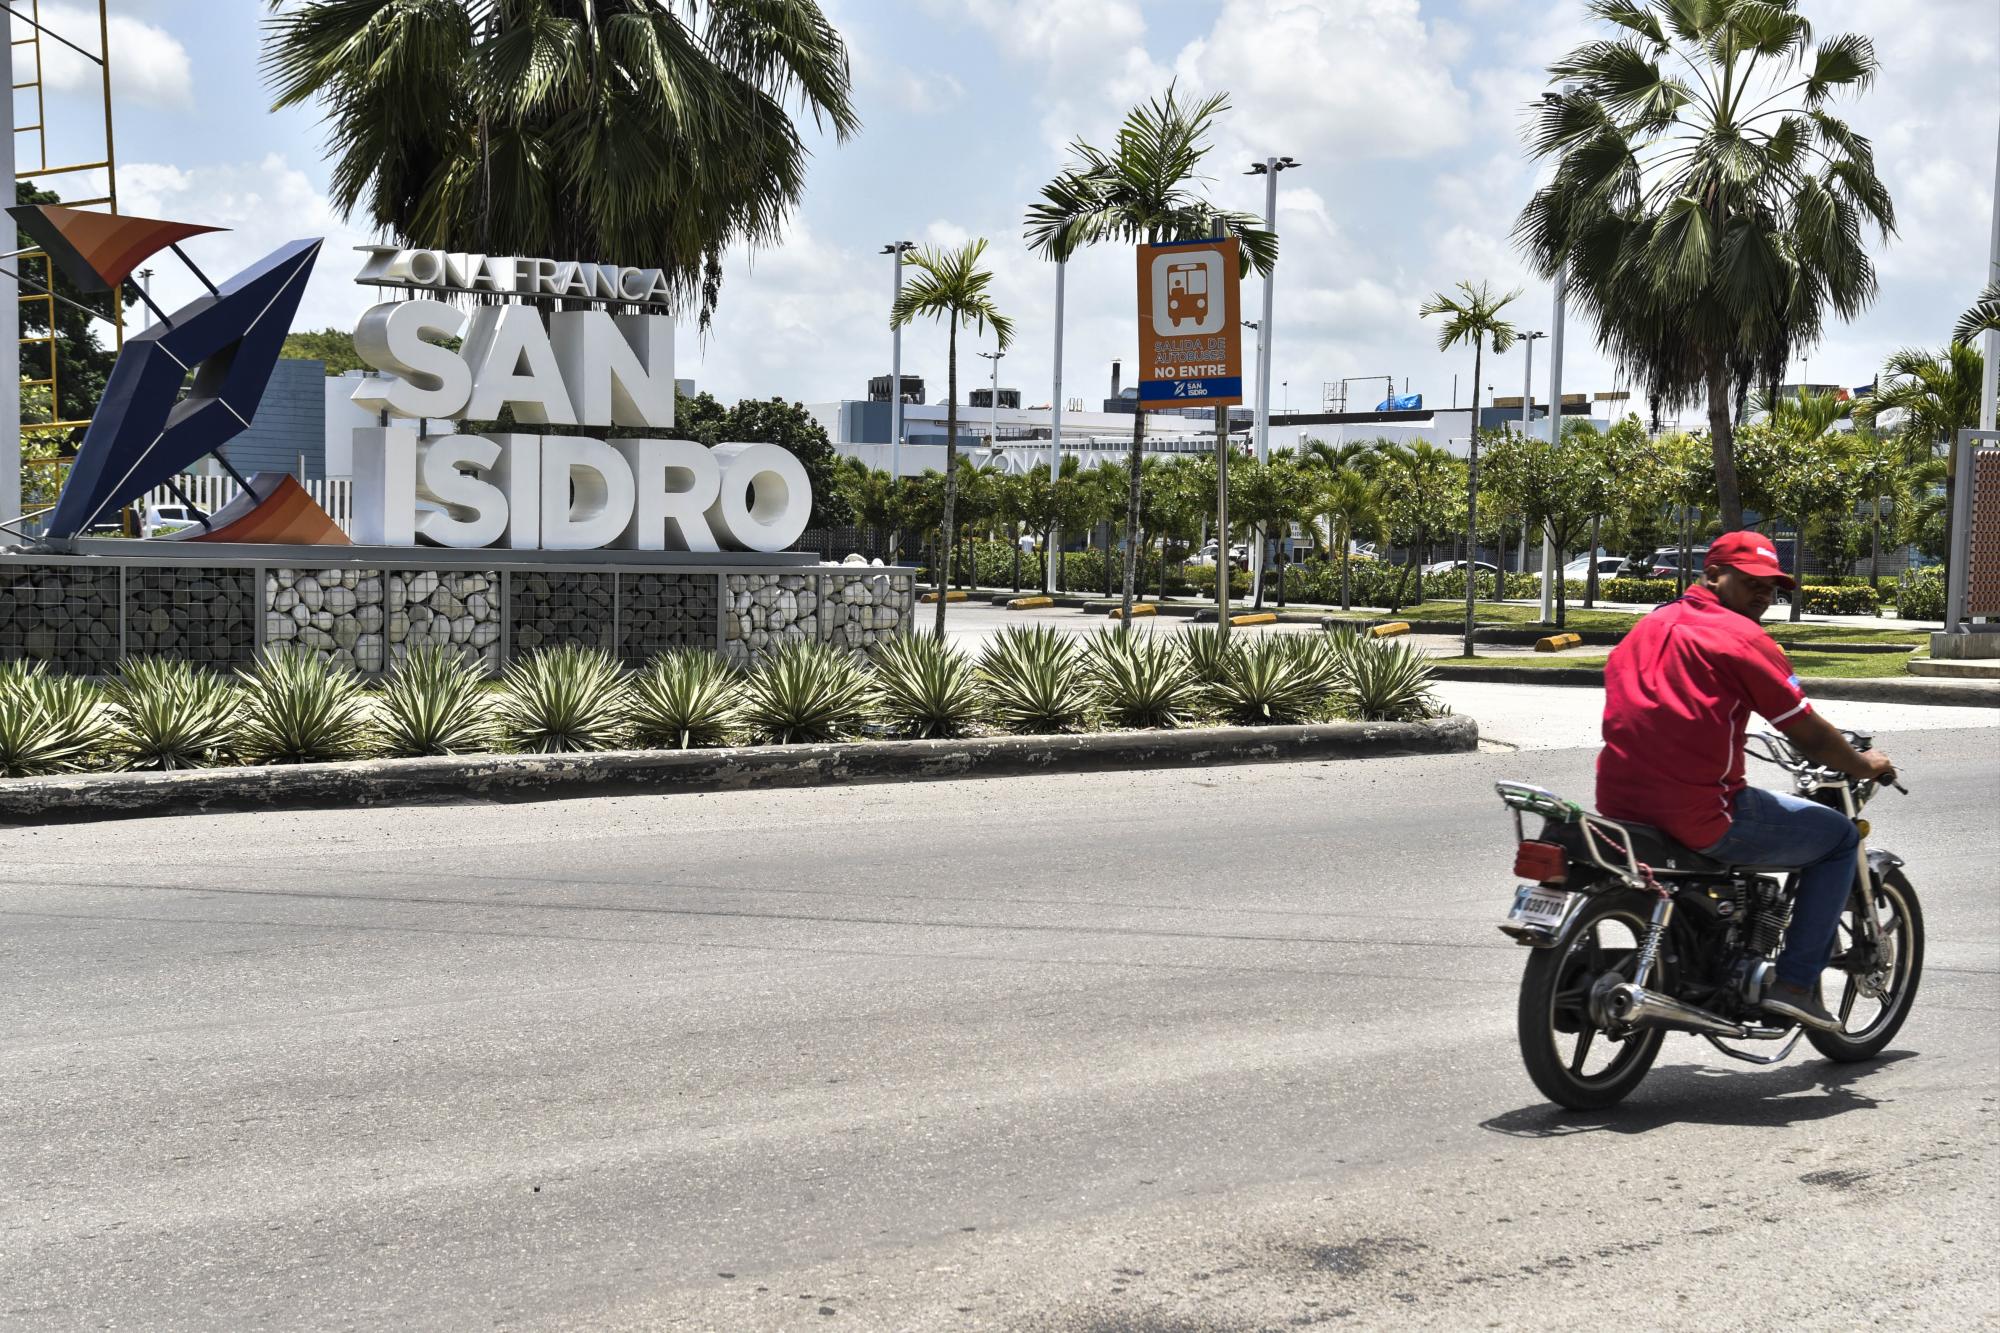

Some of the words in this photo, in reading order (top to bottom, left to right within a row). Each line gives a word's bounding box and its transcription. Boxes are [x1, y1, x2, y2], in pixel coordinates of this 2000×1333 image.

[353, 245, 500, 290] ZONA
[512, 256, 672, 302] FRANCA
[1155, 339, 1203, 352] SALIDA
[1207, 337, 1226, 349] DE
[1155, 350, 1225, 363] AUTOBUSES
[352, 300, 675, 428] SAN
[1155, 367, 1175, 378] NO
[1179, 364, 1226, 377] ENTRE
[352, 427, 812, 552] ISIDRO
